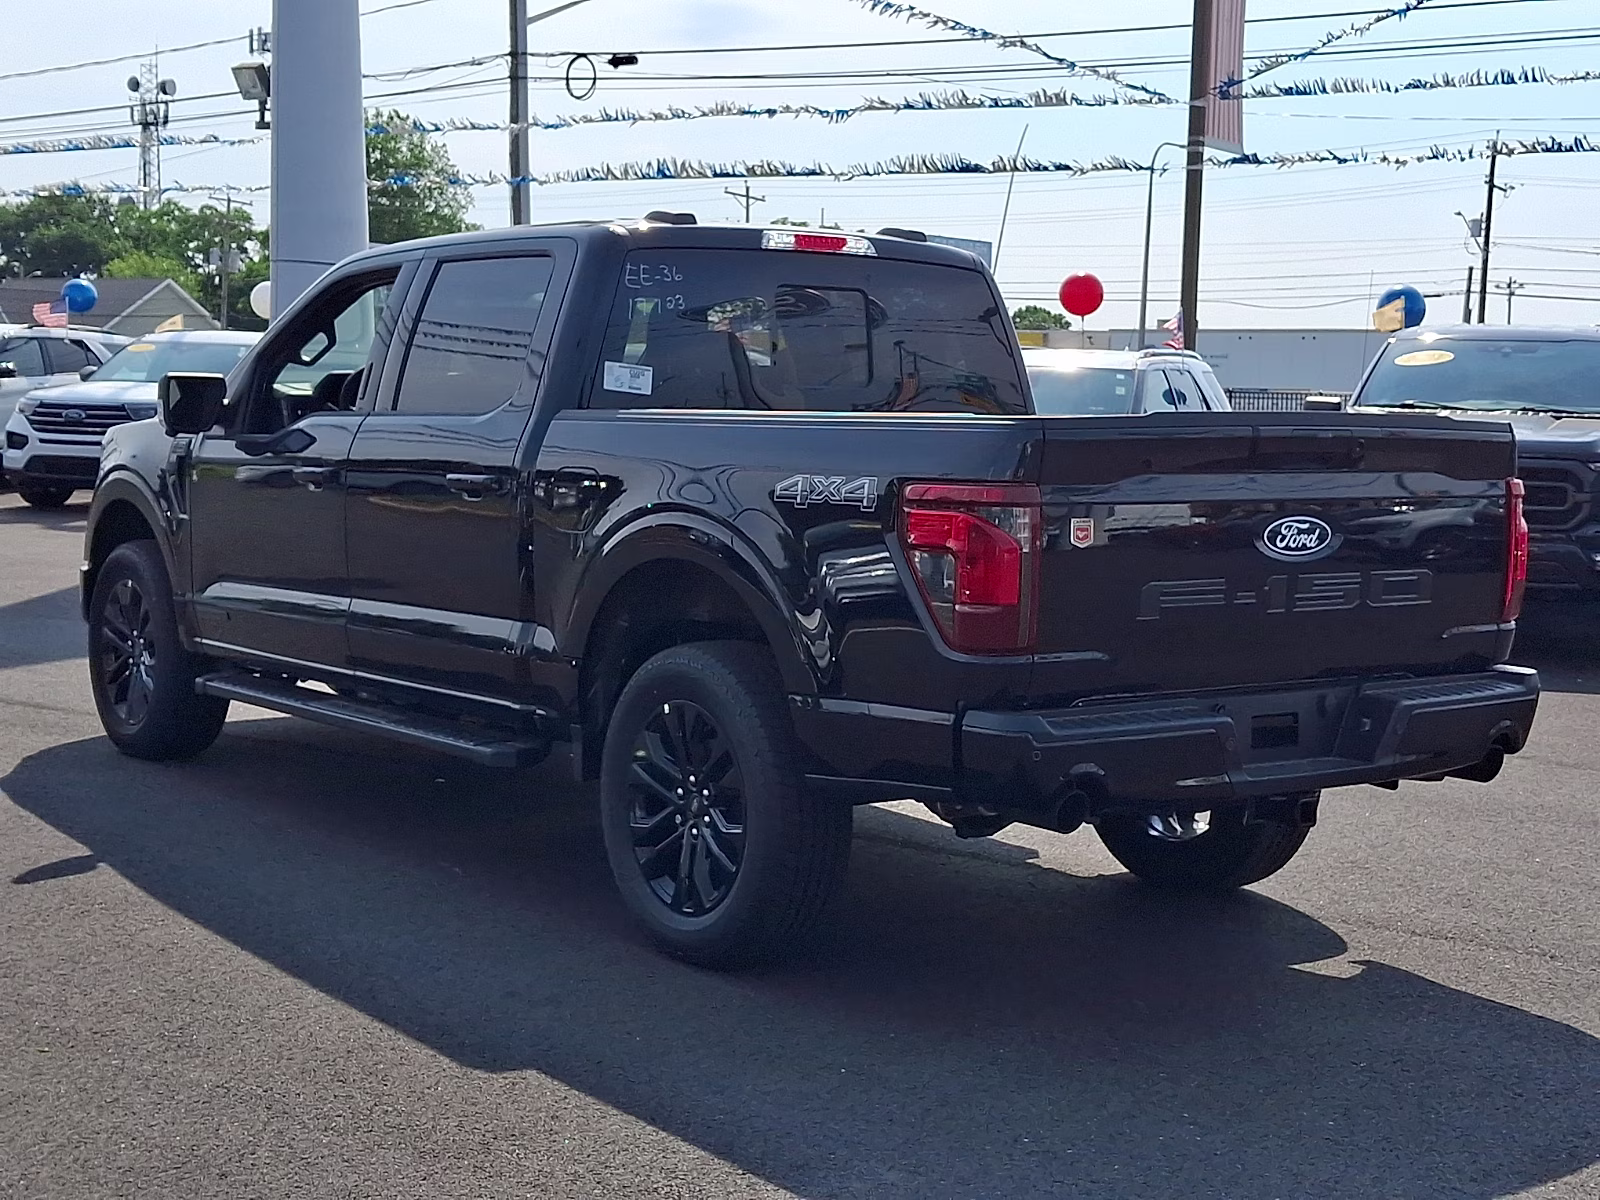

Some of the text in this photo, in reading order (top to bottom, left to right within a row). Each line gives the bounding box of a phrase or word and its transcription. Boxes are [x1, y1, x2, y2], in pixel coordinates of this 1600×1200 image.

[625, 262, 683, 288] EE-36
[1275, 521, 1320, 548] Ford
[1136, 569, 1432, 620] F-150
